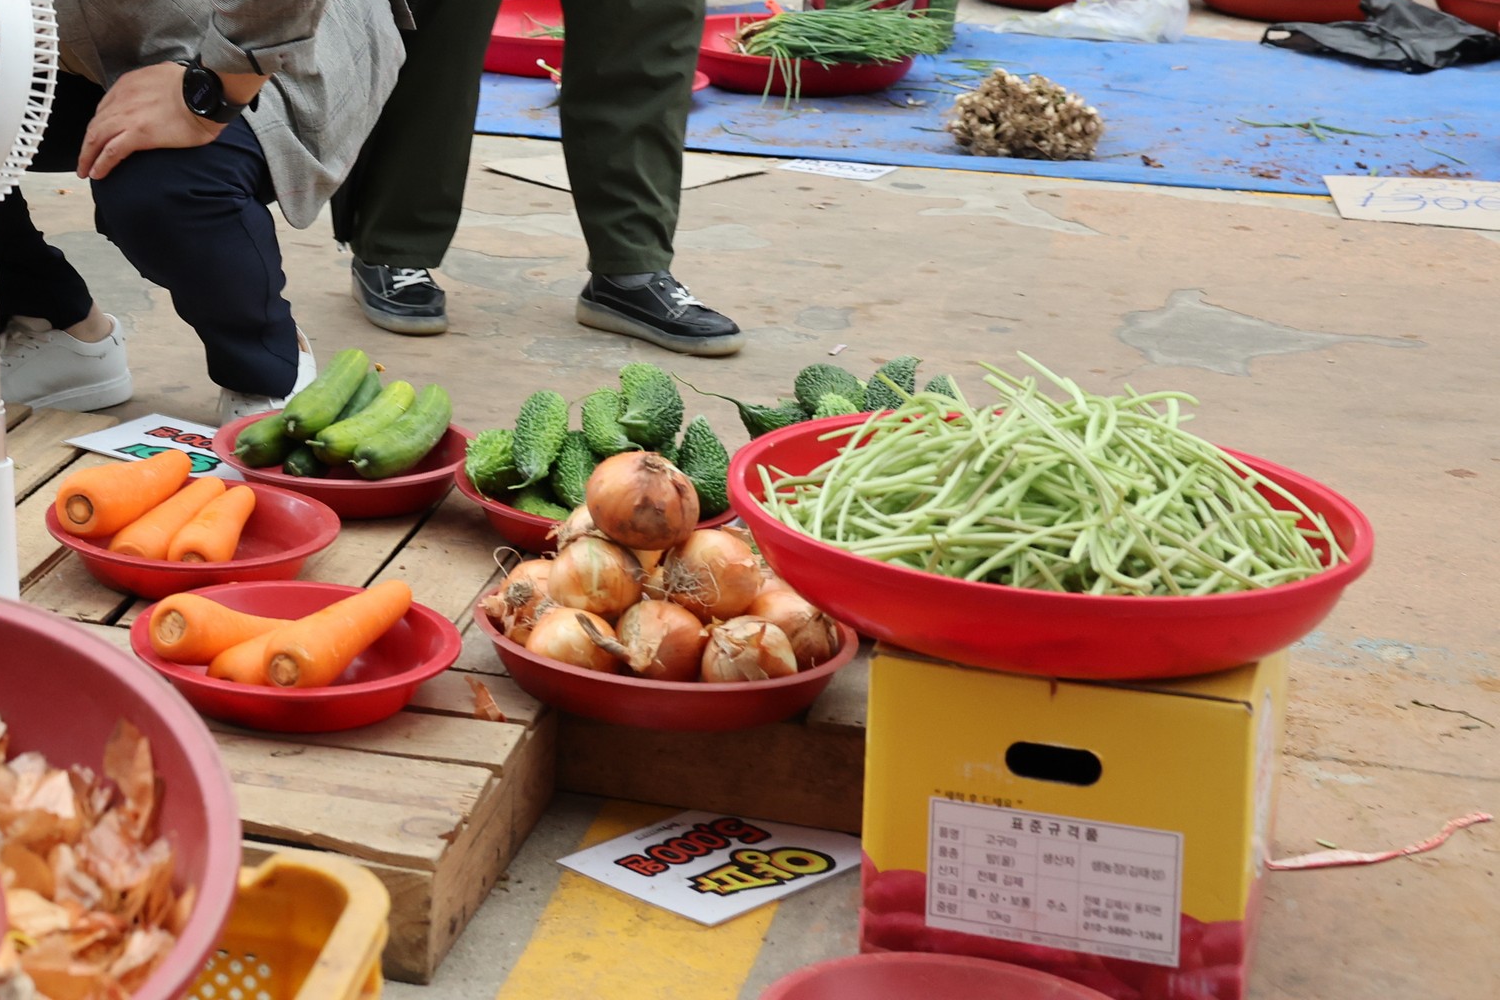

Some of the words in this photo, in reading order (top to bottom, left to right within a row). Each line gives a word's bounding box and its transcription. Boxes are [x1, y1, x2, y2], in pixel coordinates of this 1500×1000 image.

[612, 817, 773, 877] 5,000원
[985, 834, 1018, 848] 고구마
[686, 847, 837, 897] 양파
